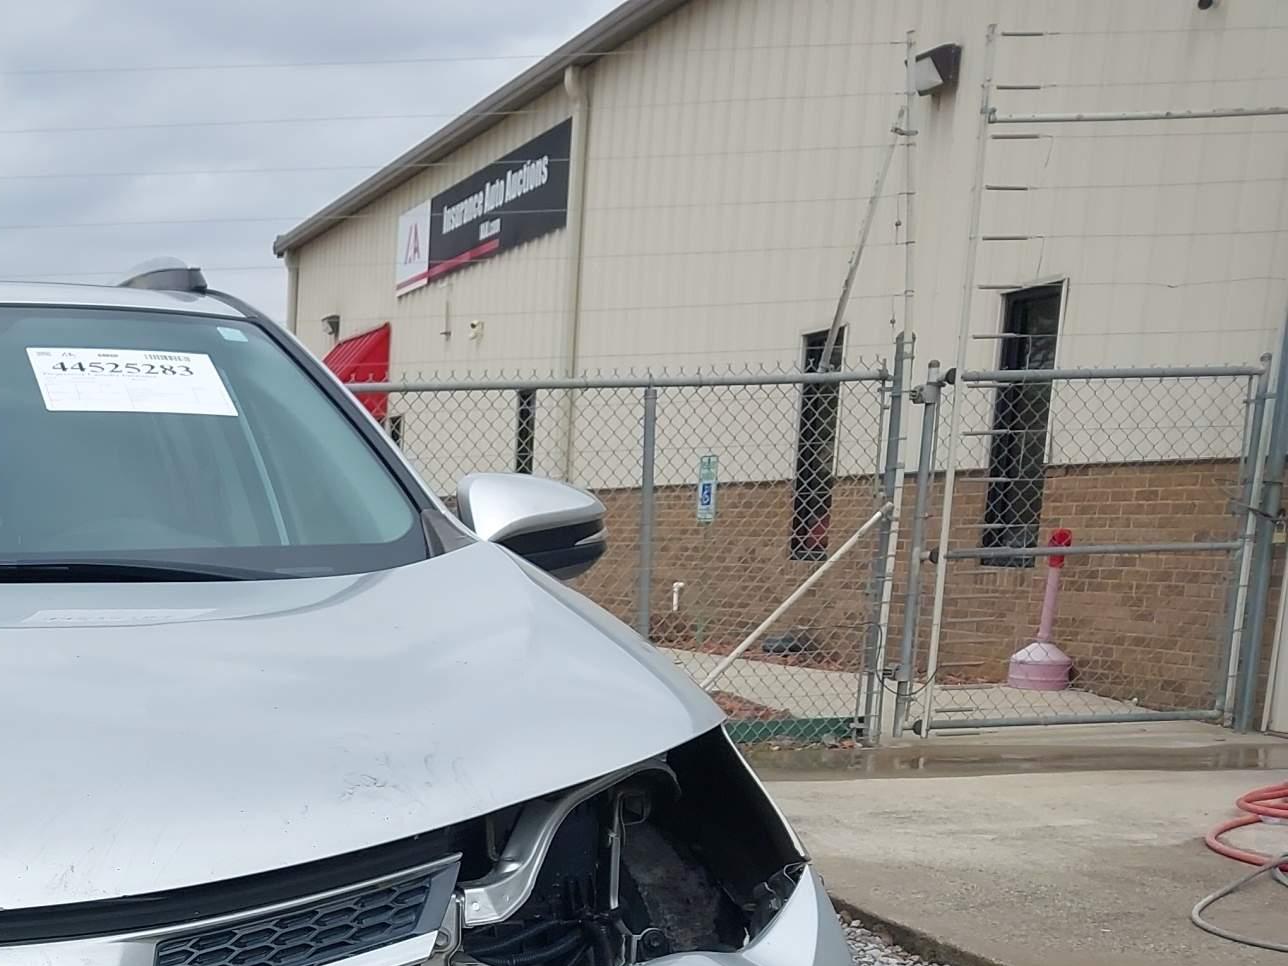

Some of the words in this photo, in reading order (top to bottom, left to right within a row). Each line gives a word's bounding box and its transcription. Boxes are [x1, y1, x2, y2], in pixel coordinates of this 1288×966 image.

[442, 190, 484, 234] Insurance
[484, 178, 505, 214] Auto
[505, 155, 548, 203] Auctions
[52, 361, 194, 376] 44525283
